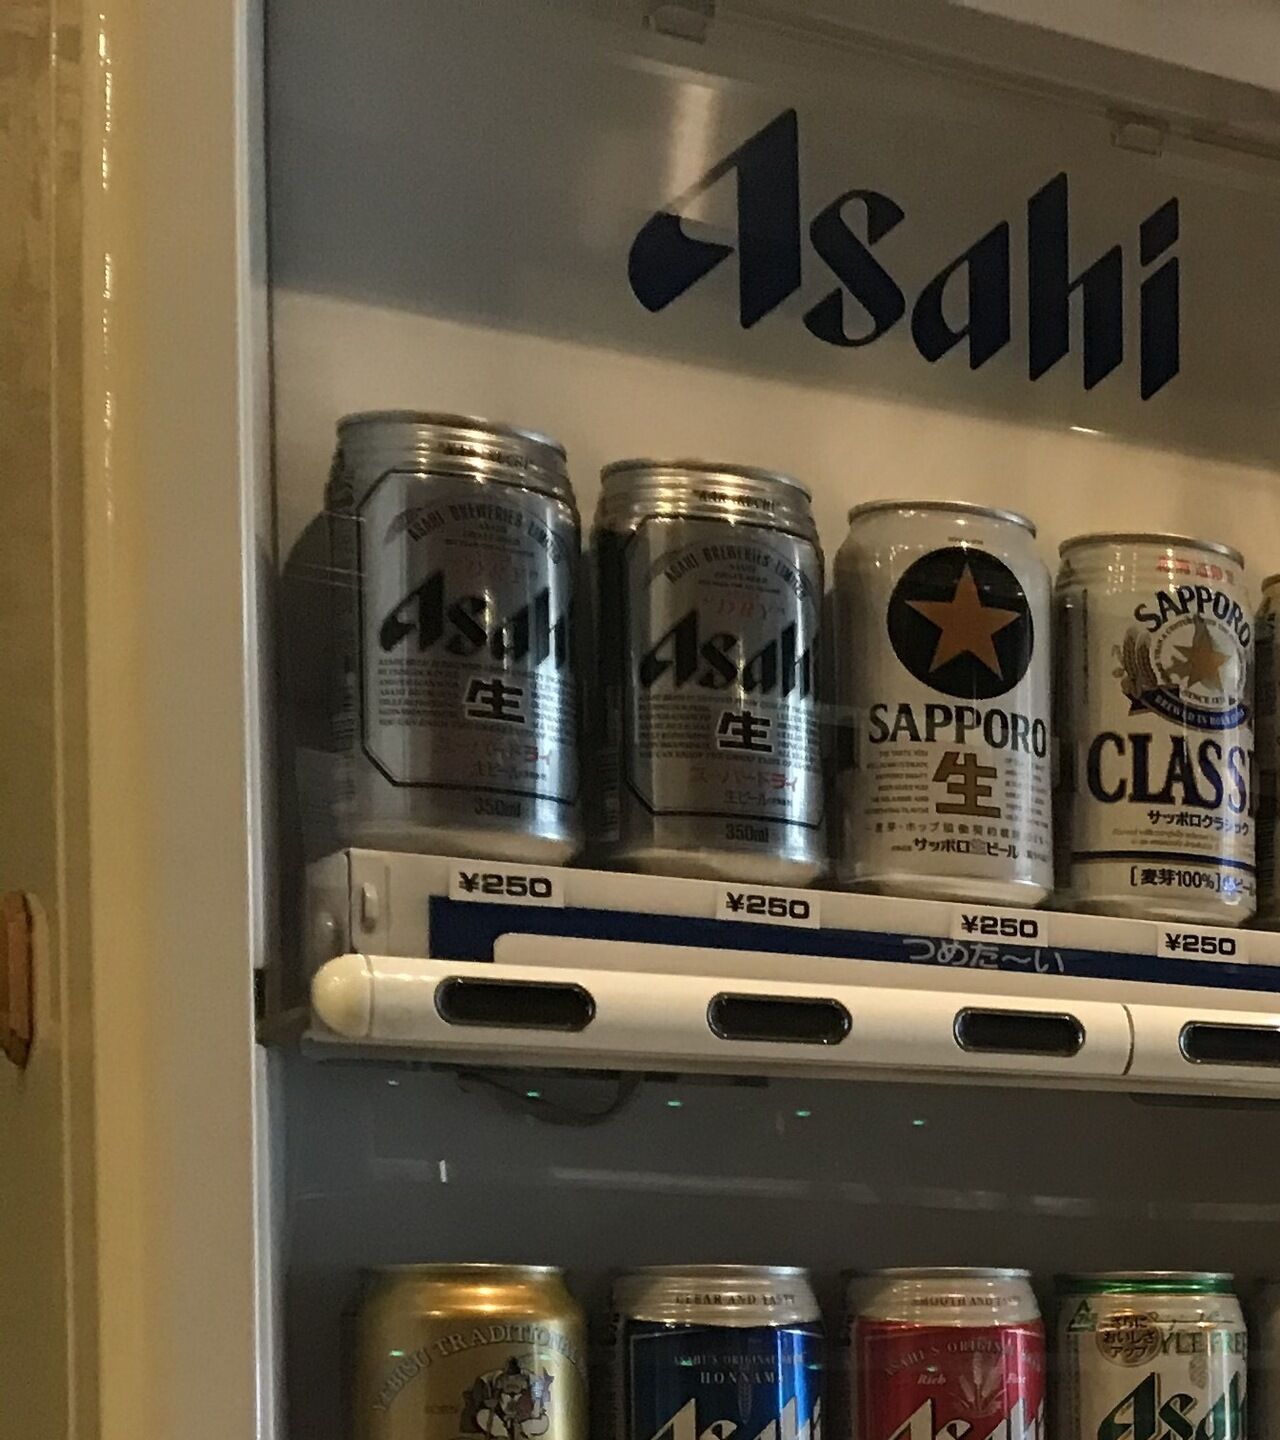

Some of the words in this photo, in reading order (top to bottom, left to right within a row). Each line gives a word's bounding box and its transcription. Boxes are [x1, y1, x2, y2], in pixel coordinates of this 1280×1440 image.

[628, 108, 1180, 400] Asahi
[1134, 585, 1250, 648] SAPPORO
[465, 678, 526, 724] 生
[716, 709, 773, 752] 生
[868, 703, 1047, 758] SAPPORO
[932, 751, 1001, 818] 生
[459, 872, 553, 899] ¥250
[726, 892, 810, 919] ¥250
[961, 914, 1038, 939] ¥250
[1165, 933, 1236, 957] ¥250
[675, 1293, 723, 1305] CLEAR
[728, 1294, 756, 1305] AND
[1102, 1331, 1156, 1344] おいしさ
[1110, 1344, 1148, 1359] アップ
[917, 1374, 946, 1385] Rich
